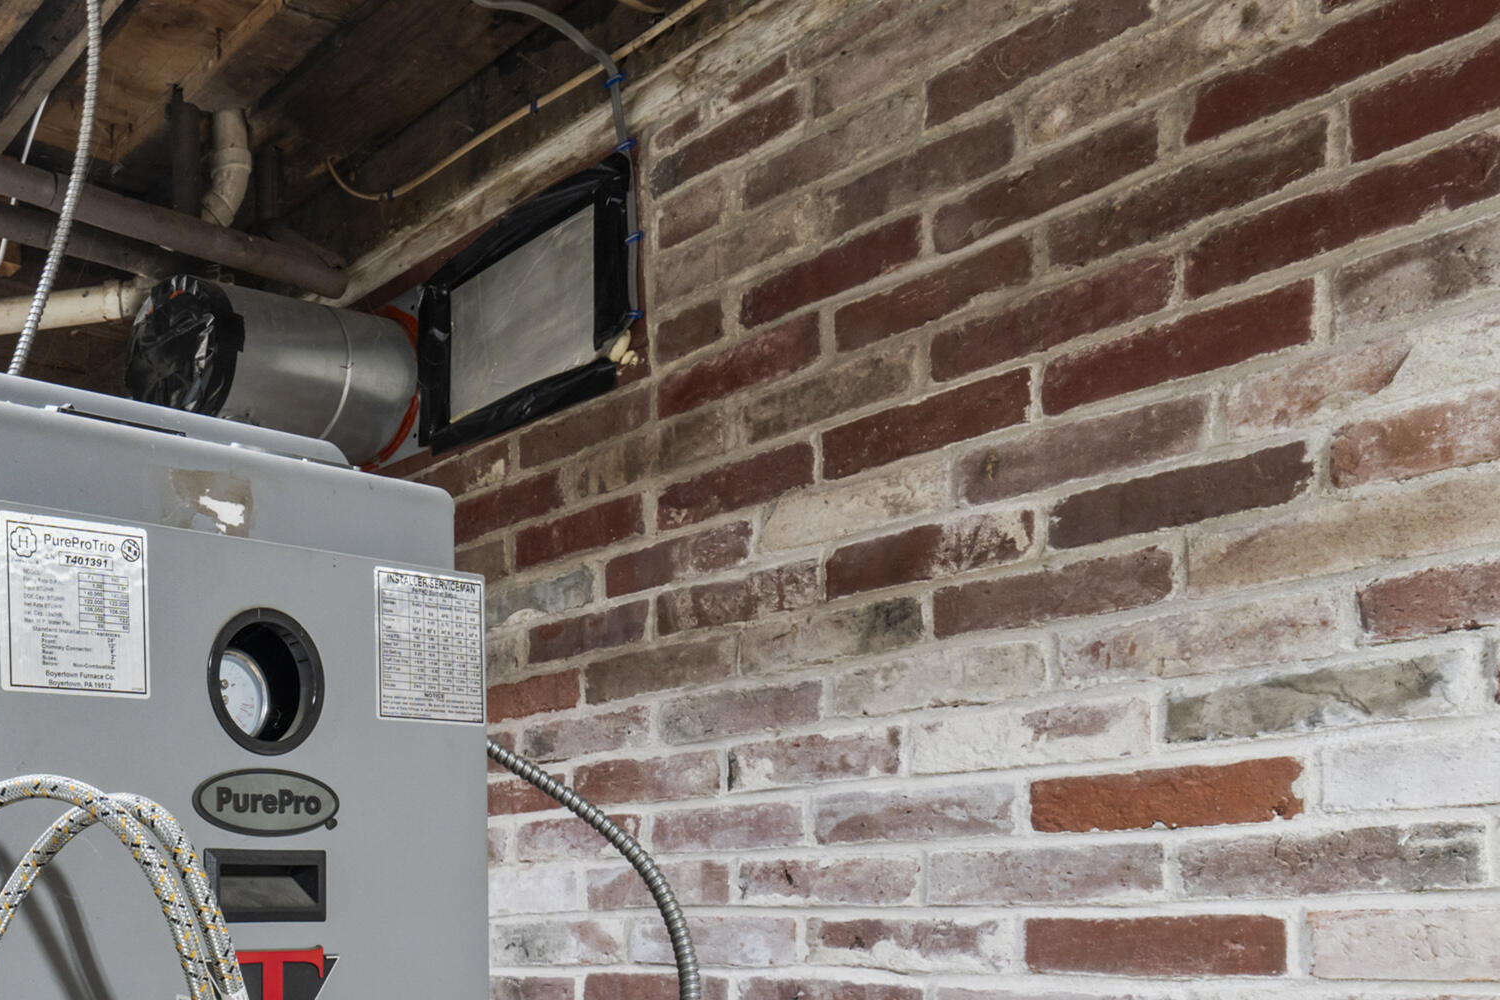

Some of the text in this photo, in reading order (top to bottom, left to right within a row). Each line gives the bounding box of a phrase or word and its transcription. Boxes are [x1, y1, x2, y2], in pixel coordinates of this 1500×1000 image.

[43, 533, 116, 553] PureProTrio
[65, 555, 109, 568] T401391
[215, 786, 322, 816] PurePro
